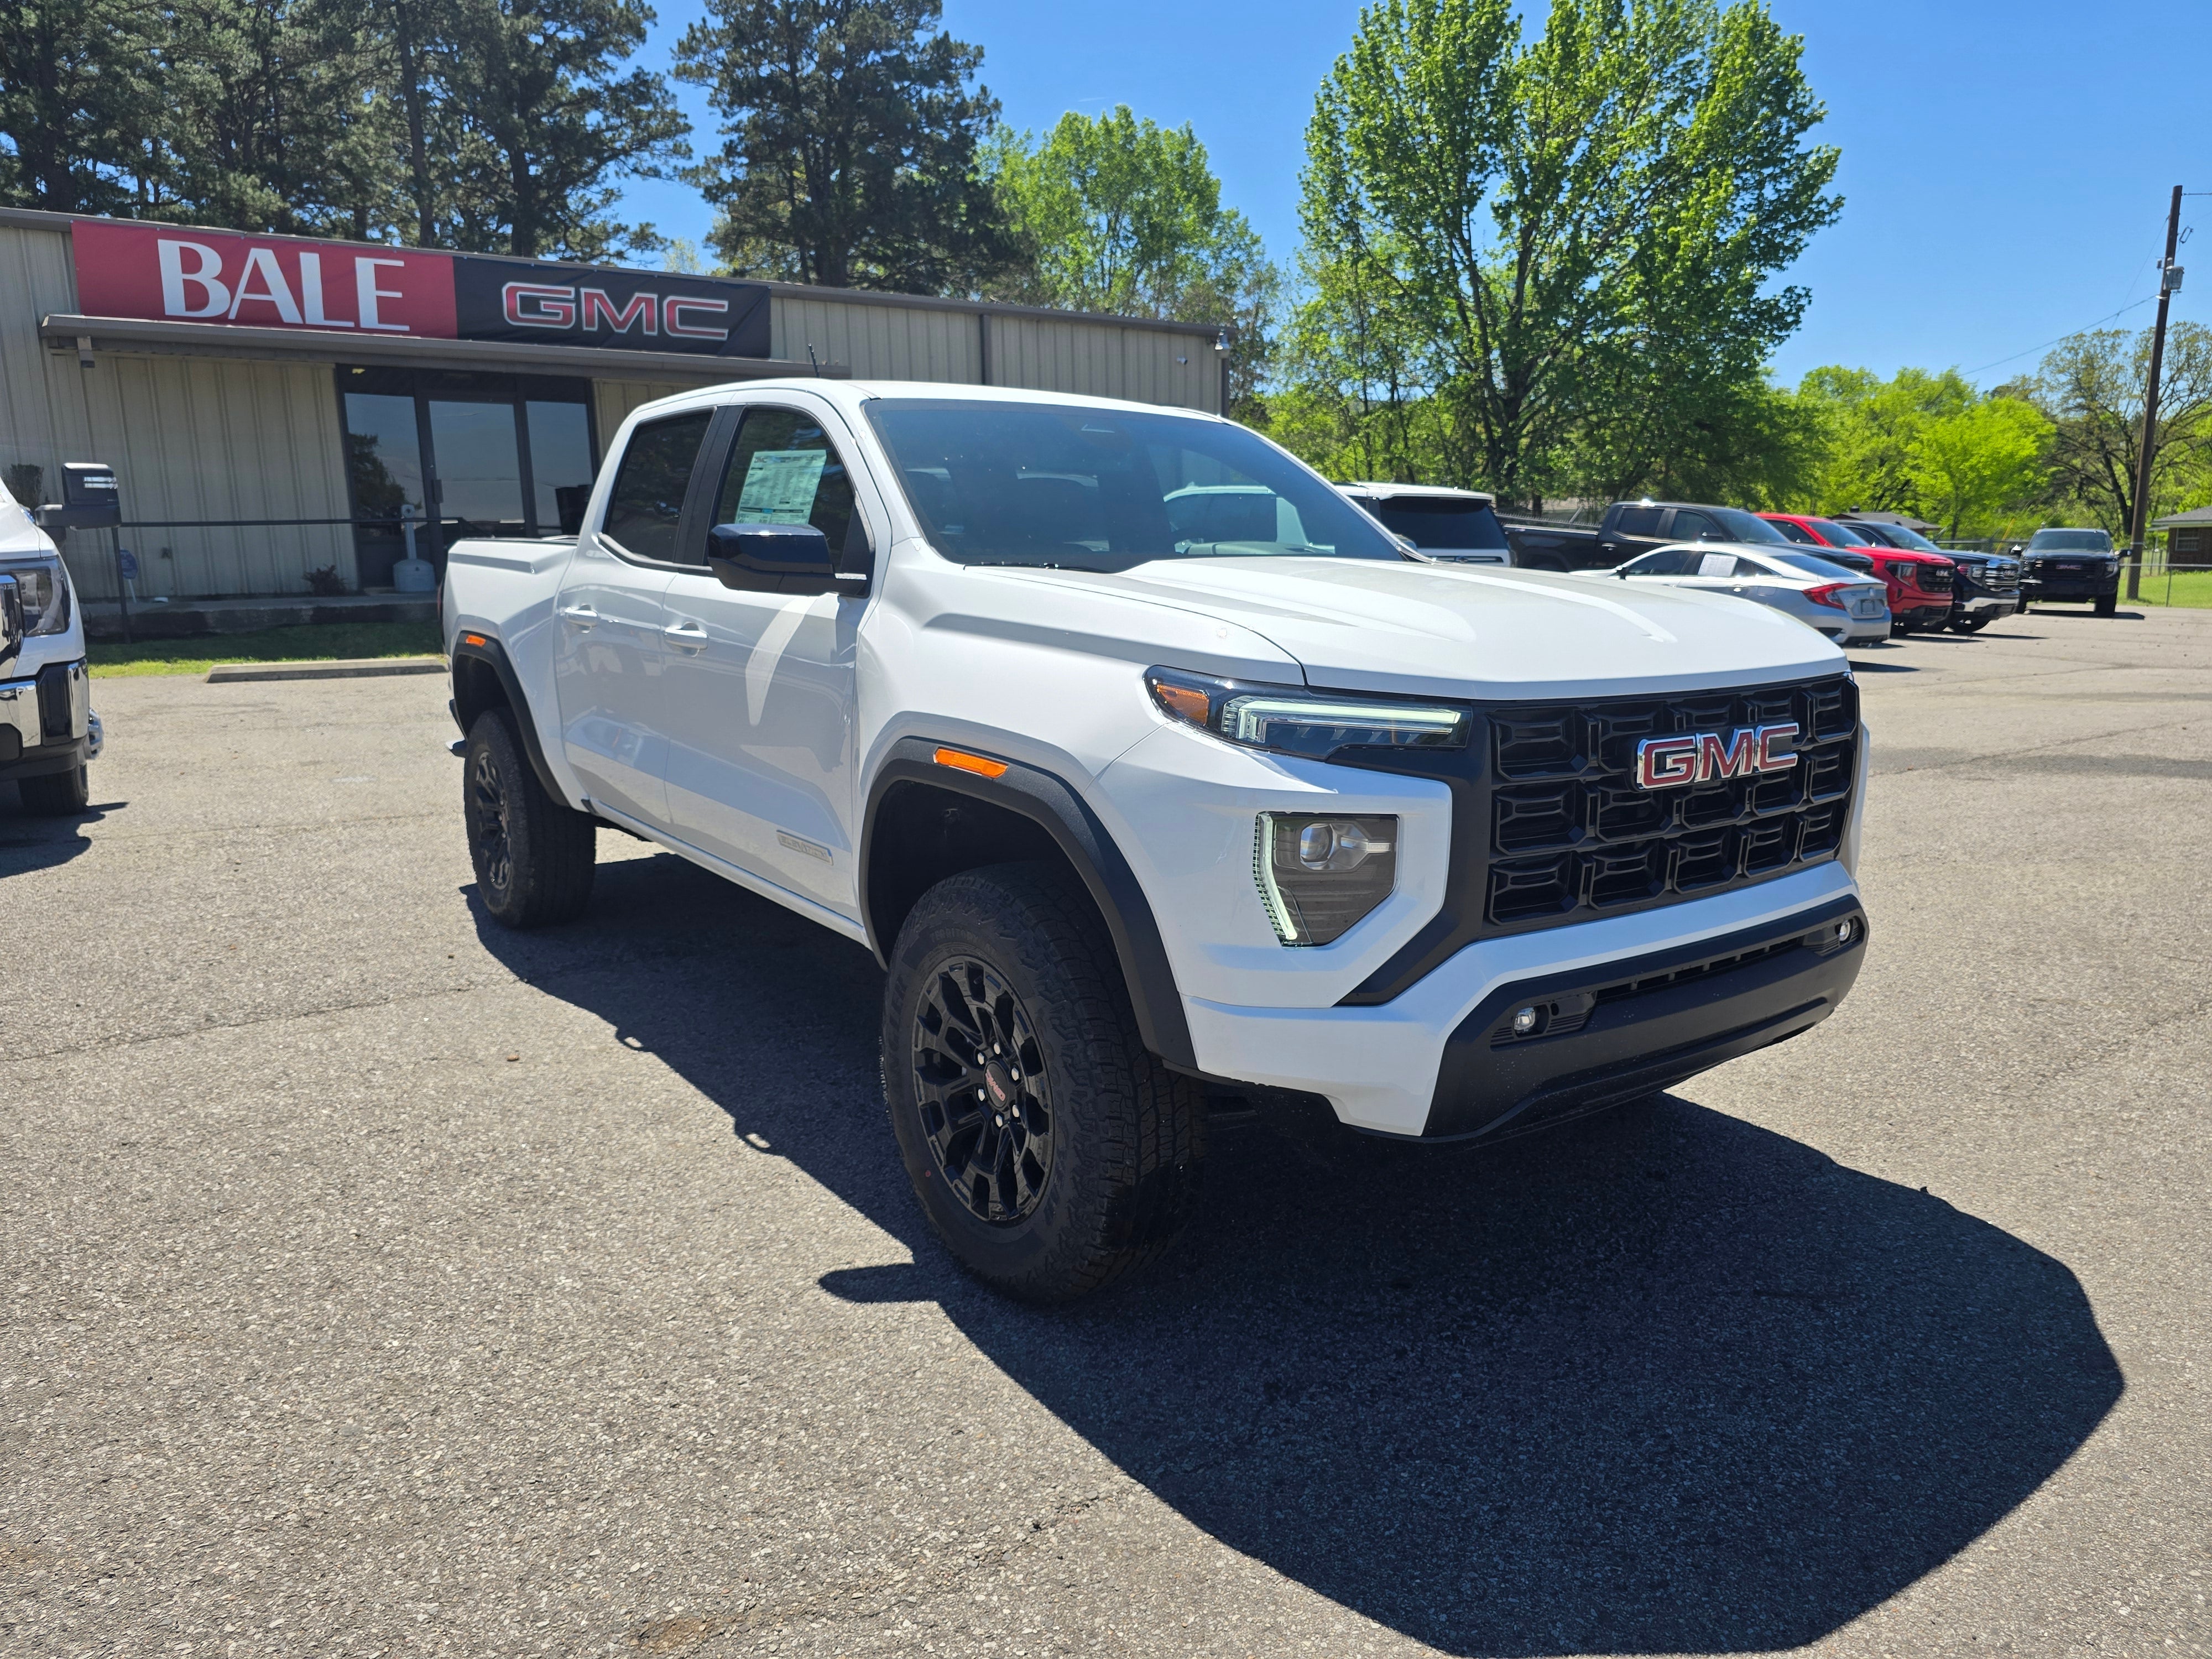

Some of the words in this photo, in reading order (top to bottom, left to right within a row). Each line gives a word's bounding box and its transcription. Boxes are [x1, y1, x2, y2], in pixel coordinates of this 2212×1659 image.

[158, 239, 409, 331] BALE
[502, 281, 729, 341] GMC
[1636, 722, 1799, 790] GMC
[985, 1069, 1006, 1102] GMC
